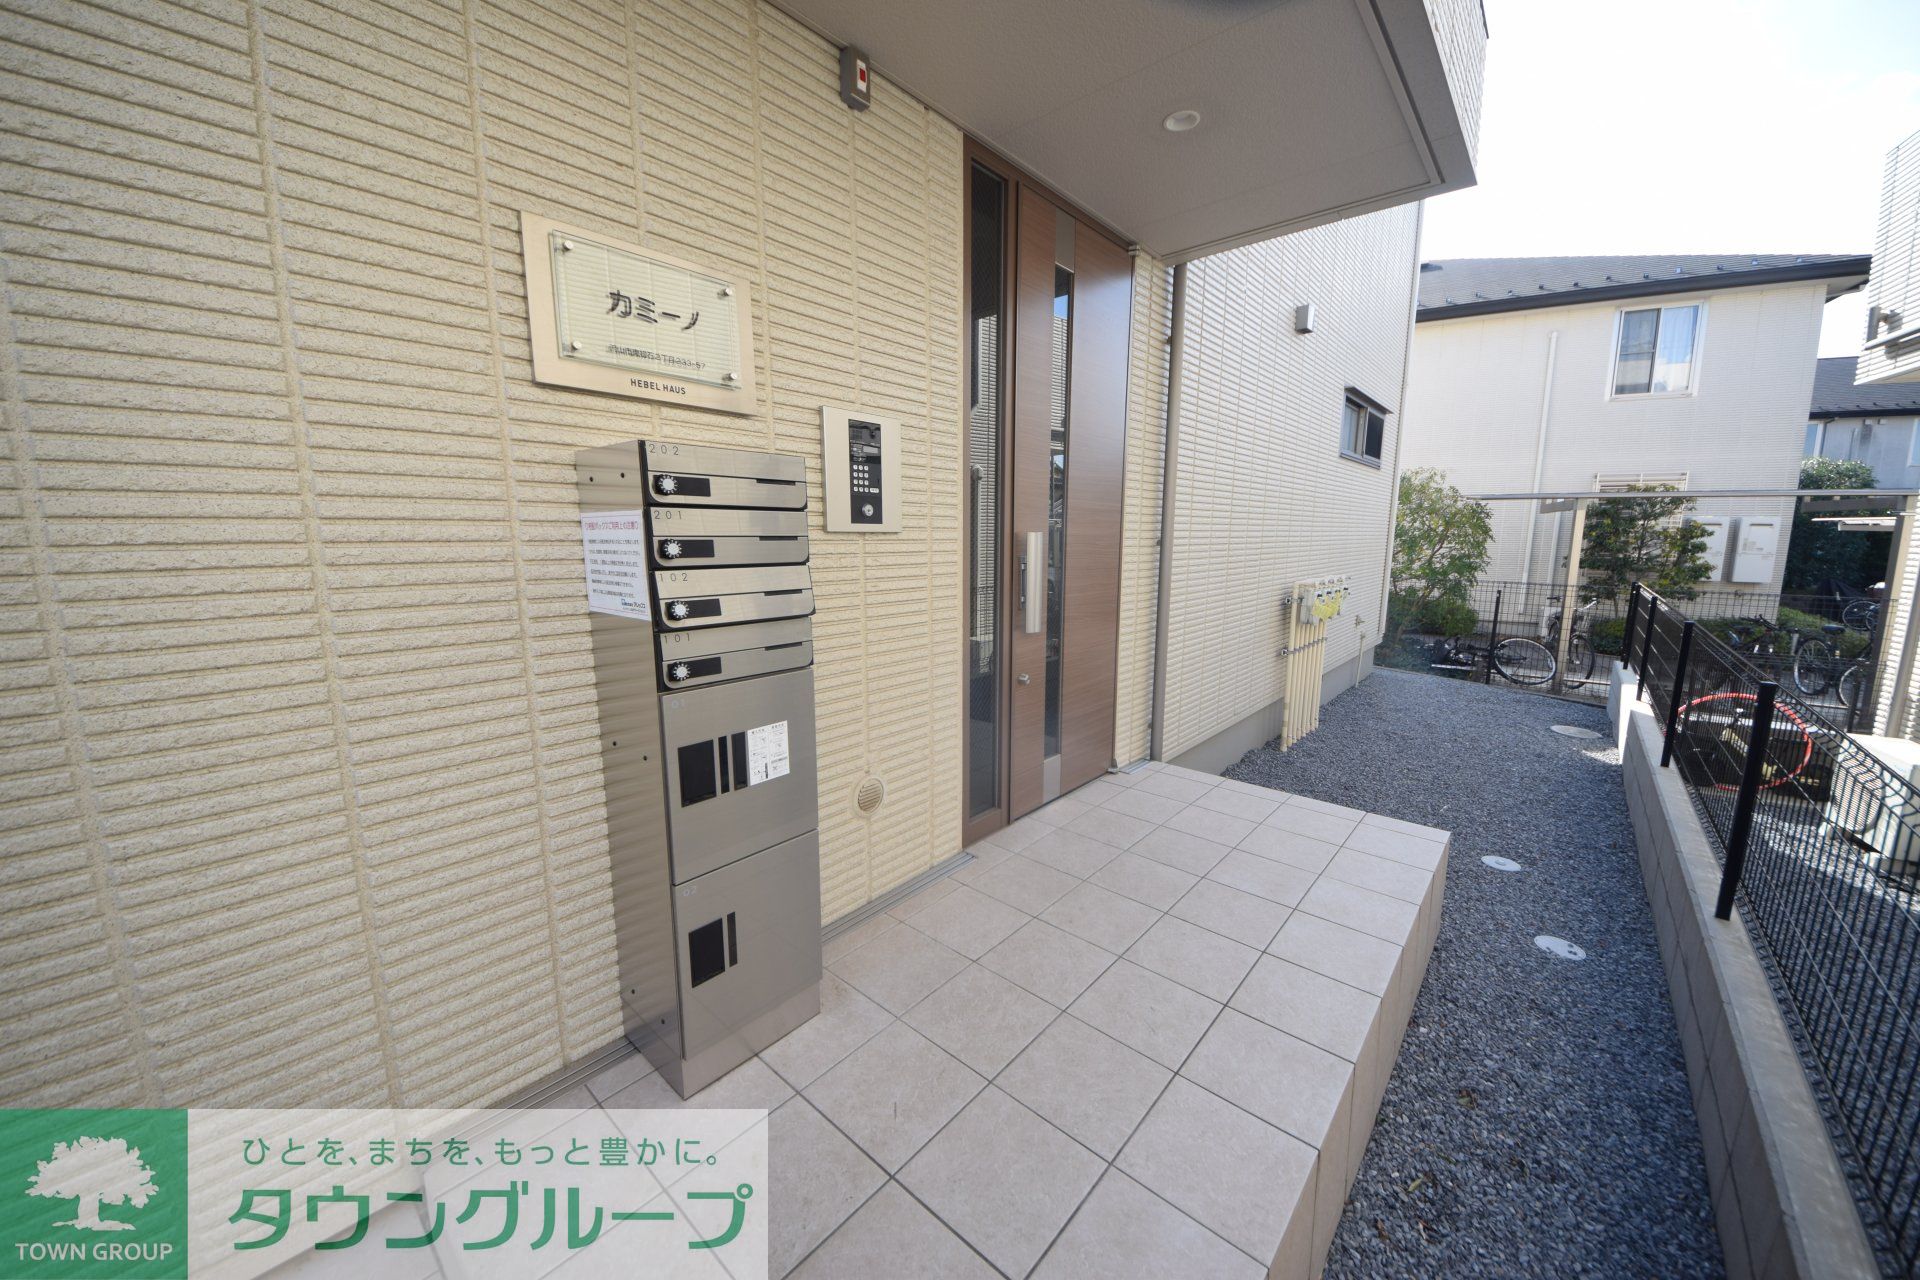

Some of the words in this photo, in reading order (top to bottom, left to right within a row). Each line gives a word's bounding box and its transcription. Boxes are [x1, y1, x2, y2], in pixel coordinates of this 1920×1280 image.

[606, 290, 699, 331] カミーノ
[630, 378, 661, 391] HEBEL
[662, 383, 686, 395] HAUS
[648, 443, 680, 456] 202
[653, 510, 683, 520] 201
[659, 572, 688, 582] 102
[664, 632, 690, 643] 101
